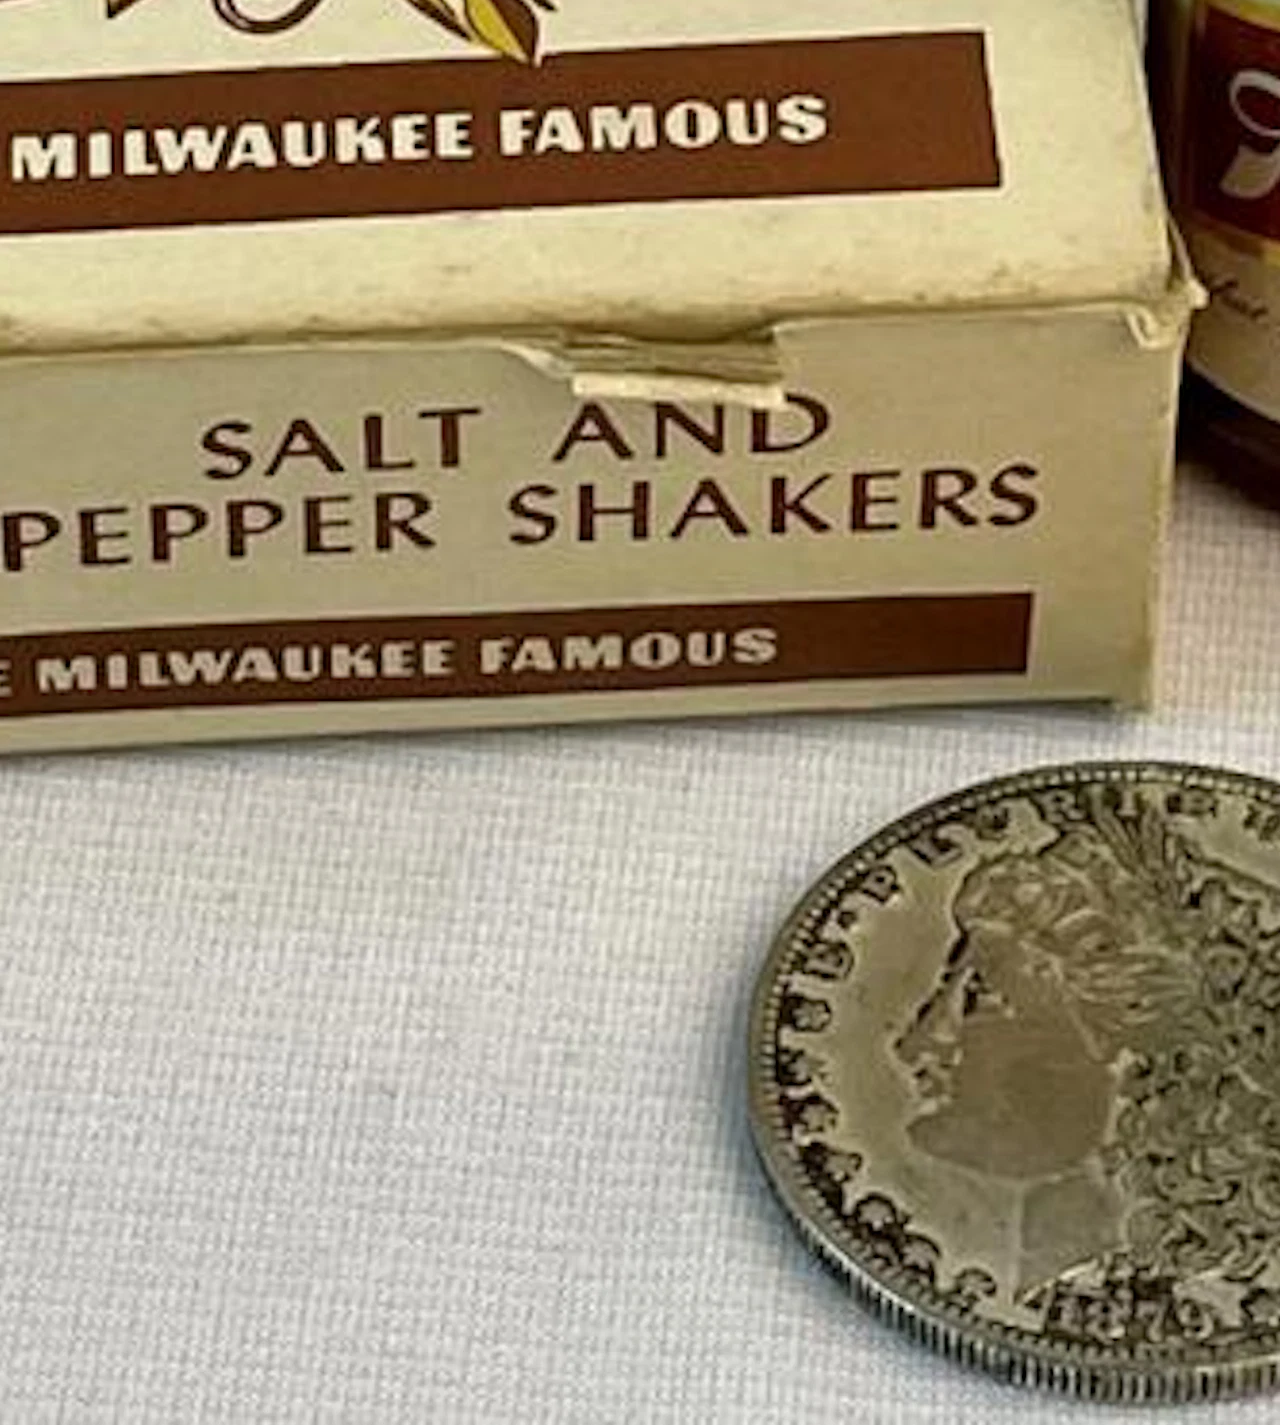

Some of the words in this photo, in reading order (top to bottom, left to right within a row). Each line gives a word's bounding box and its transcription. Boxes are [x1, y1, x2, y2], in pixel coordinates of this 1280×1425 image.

[9, 111, 474, 182] MILWAUKEE
[498, 93, 830, 159] FAMOUS
[200, 405, 483, 482] SALT
[550, 393, 834, 464] AND
[506, 463, 1043, 548] SHAKERS
[34, 639, 455, 696] MILWAUKEE
[478, 627, 780, 677] FAMOUS
